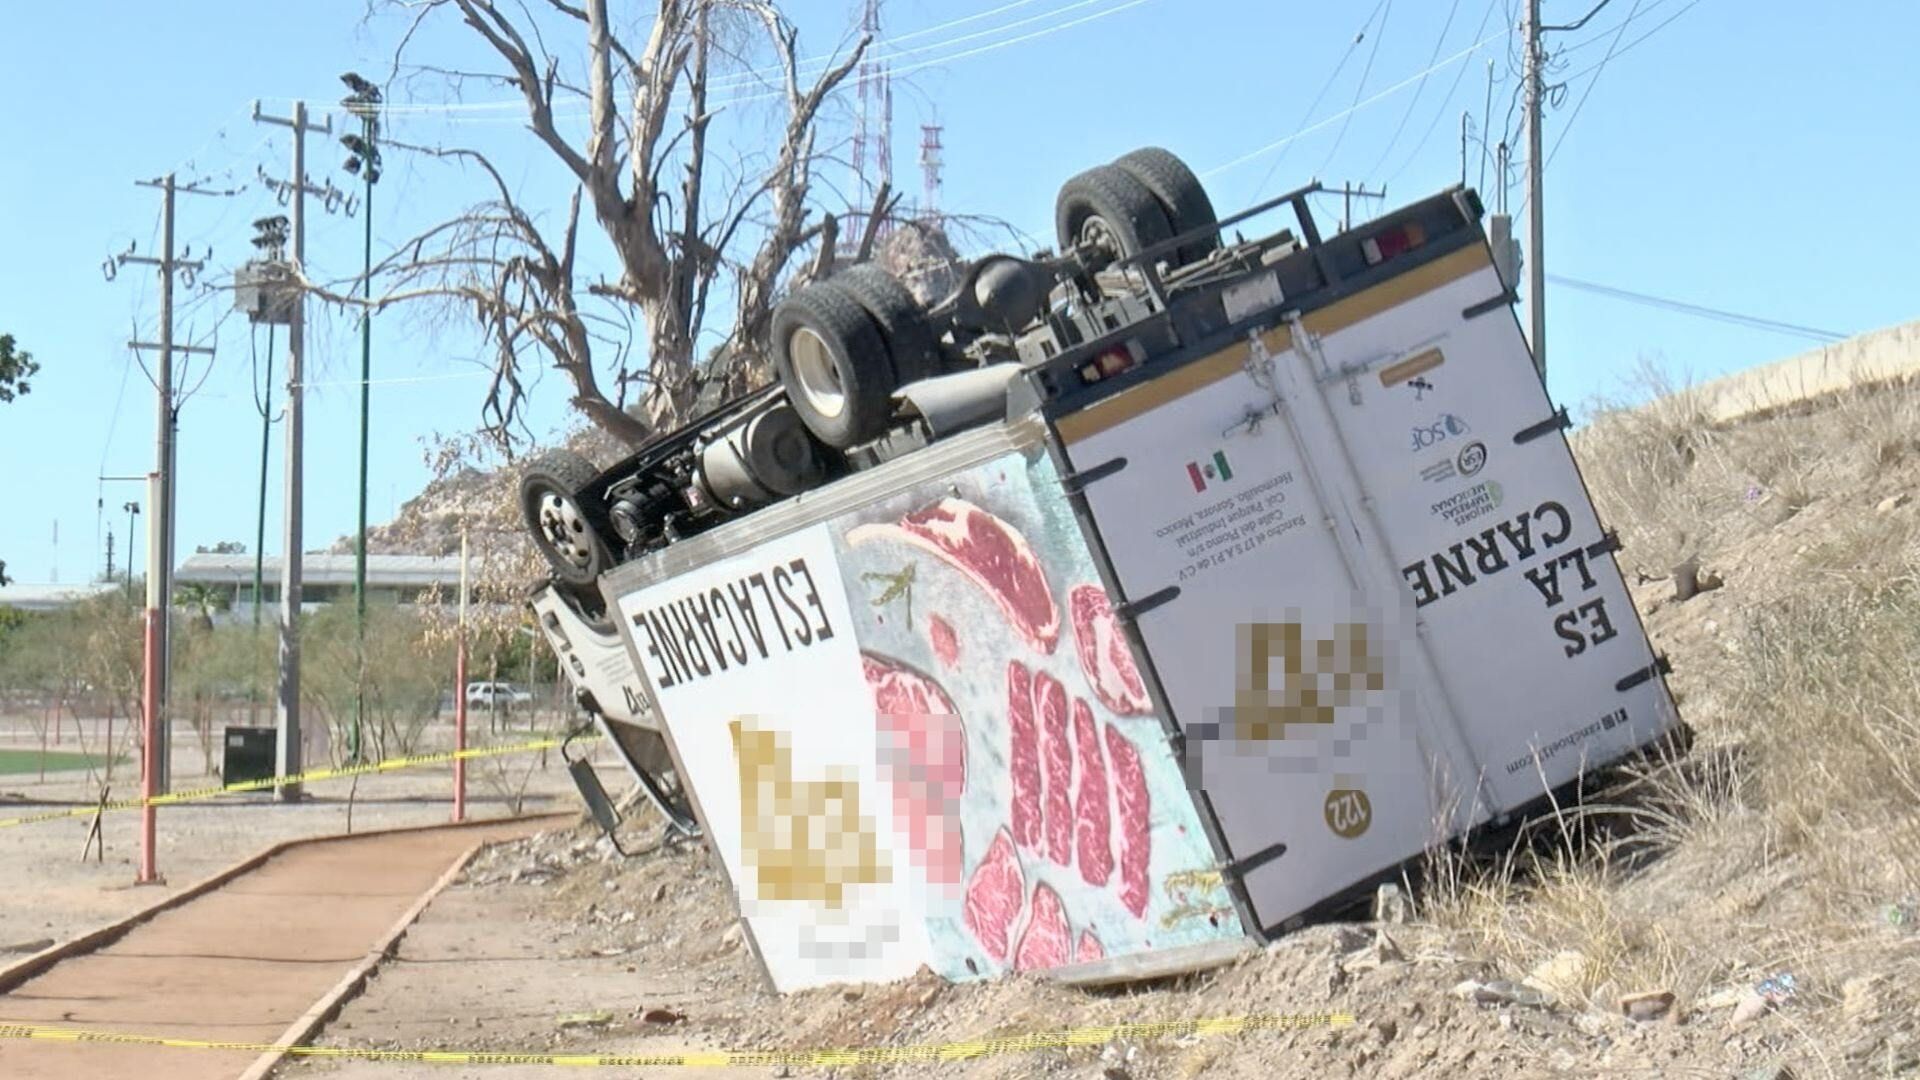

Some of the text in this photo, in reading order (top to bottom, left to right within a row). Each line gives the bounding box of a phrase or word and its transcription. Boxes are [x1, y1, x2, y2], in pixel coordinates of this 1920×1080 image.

[1412, 422, 1446, 452] SQF
[1227, 502, 1264, 523] Parque
[1441, 493, 1490, 520] EMPRESAS
[1454, 503, 1495, 526] MEJORES
[1176, 517, 1227, 548] Industrial
[1240, 521, 1257, 535] del
[1402, 501, 1572, 609] CARNE
[1523, 547, 1598, 608] LA
[1554, 597, 1618, 658] ES
[1505, 721, 1602, 774] ranchoel17com
[1327, 791, 1367, 831] 122
